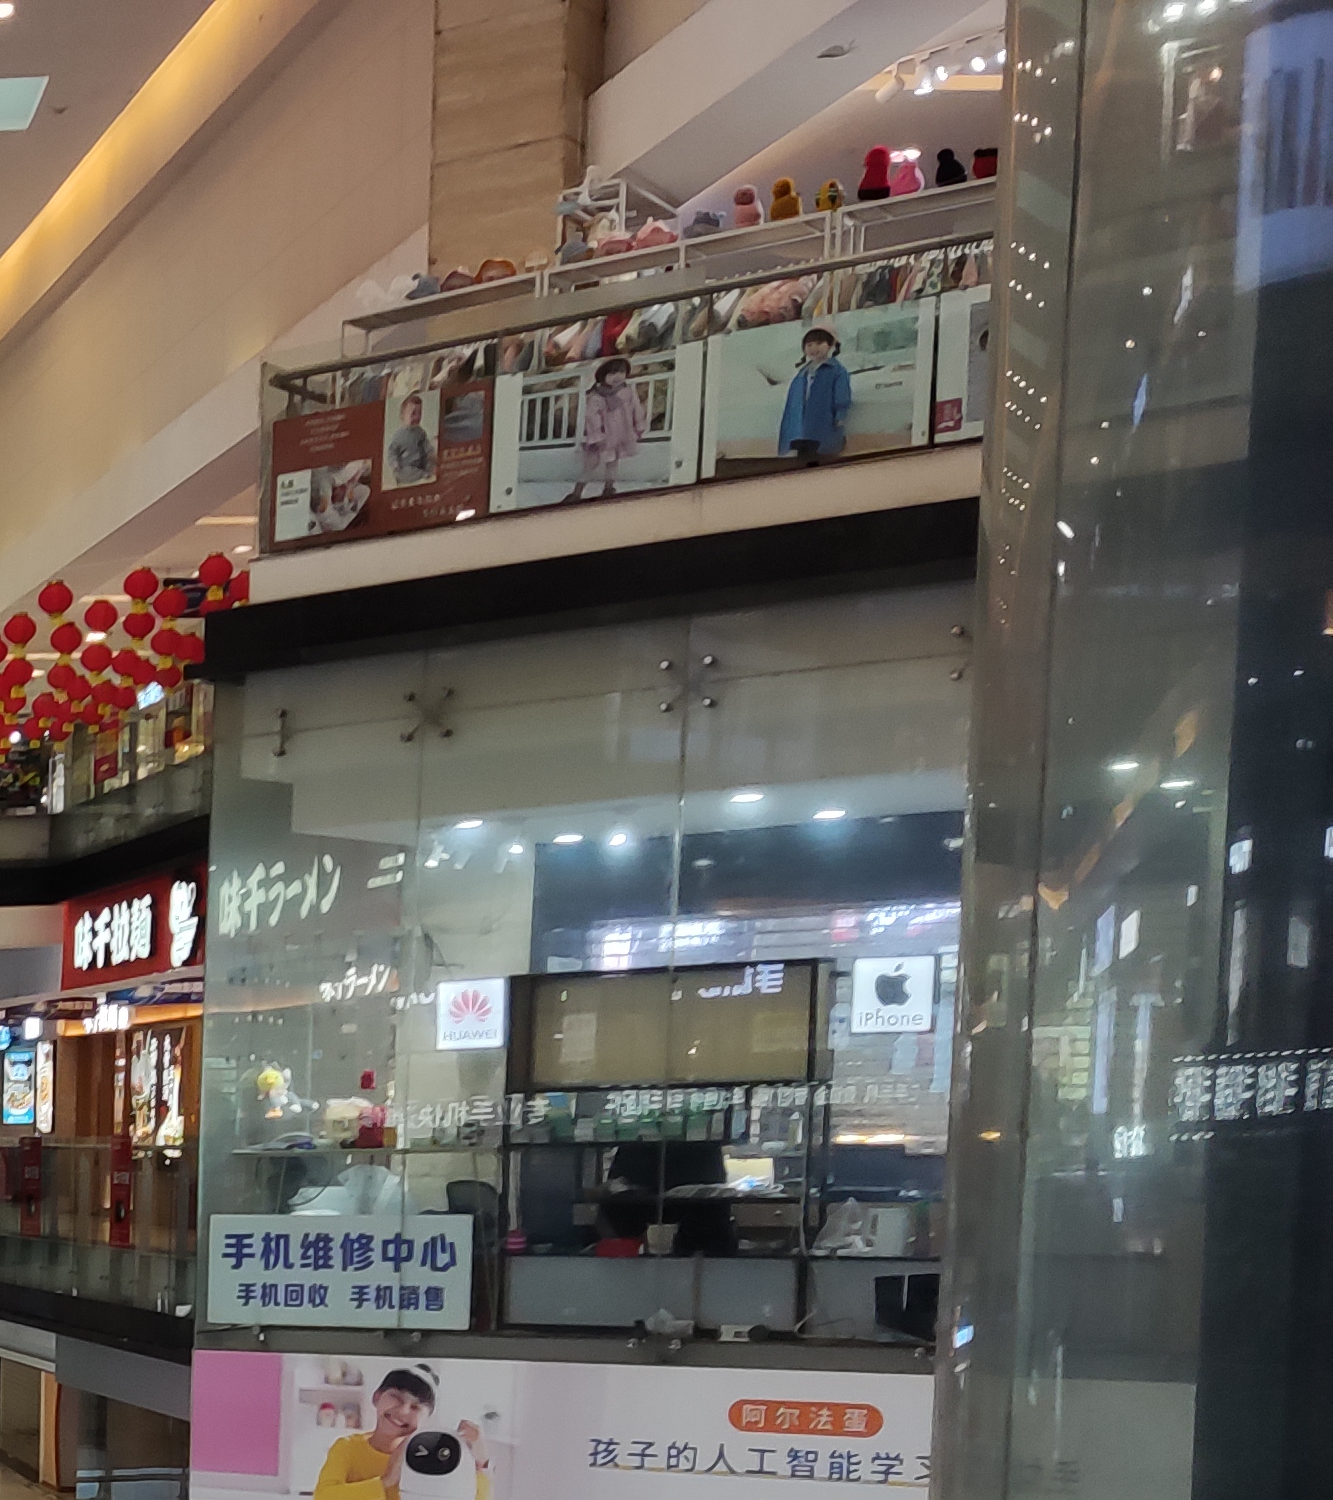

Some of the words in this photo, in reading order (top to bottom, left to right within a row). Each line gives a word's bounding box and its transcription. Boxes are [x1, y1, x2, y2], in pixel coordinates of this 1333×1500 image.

[858, 1008, 925, 1028] iPhone
[442, 1027, 498, 1042] HUAWEI
[221, 1231, 458, 1273] 手机维修中心
[236, 1282, 329, 1308] 手机回收
[741, 1403, 869, 1433] 阿尔法蛋
